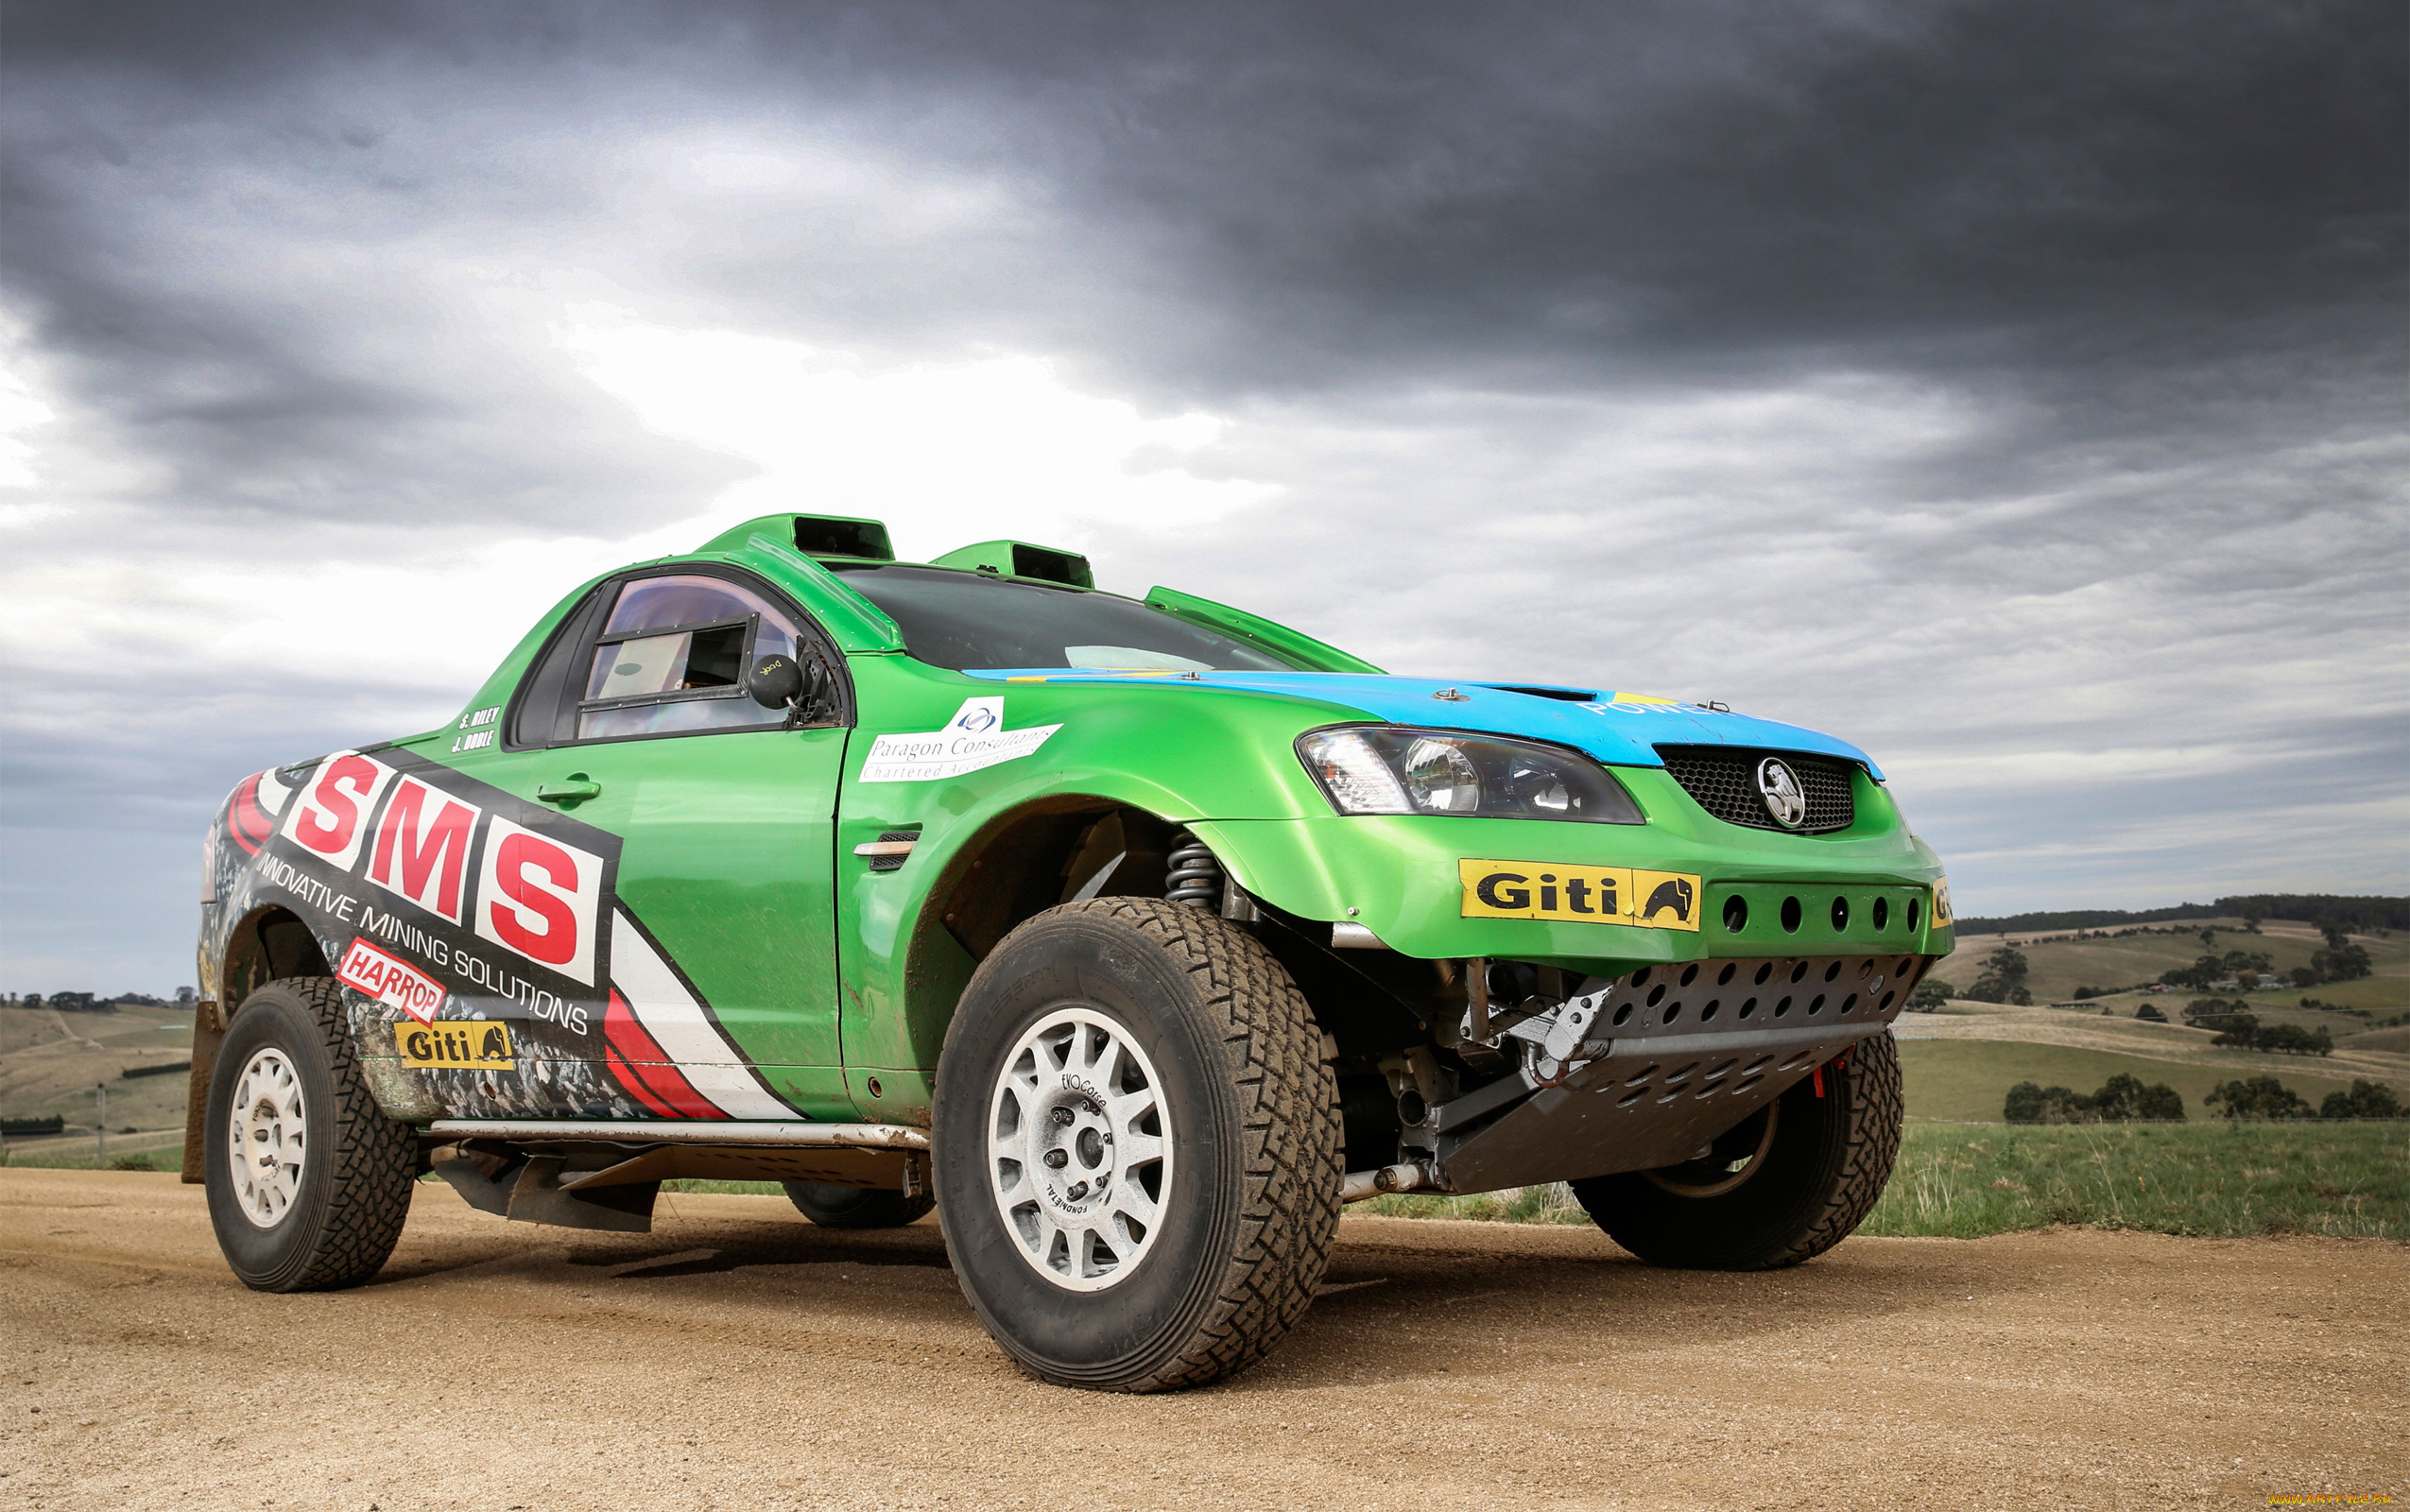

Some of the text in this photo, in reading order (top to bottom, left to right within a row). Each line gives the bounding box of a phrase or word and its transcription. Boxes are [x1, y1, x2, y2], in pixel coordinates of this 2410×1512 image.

[458, 706, 501, 730] S. RILEY
[451, 735, 461, 753] J.
[871, 728, 1053, 762] Paragon Consultants
[863, 747, 1035, 779] Chartered Accountants
[295, 754, 578, 965] SMS
[1476, 872, 1618, 916] Giti
[255, 850, 588, 1036] INNOVATIVE MINING SOLUTIONS
[347, 951, 438, 1012] HARROP
[407, 1030, 472, 1061] Giti
[1046, 1183, 1088, 1214] FONDMETAL
